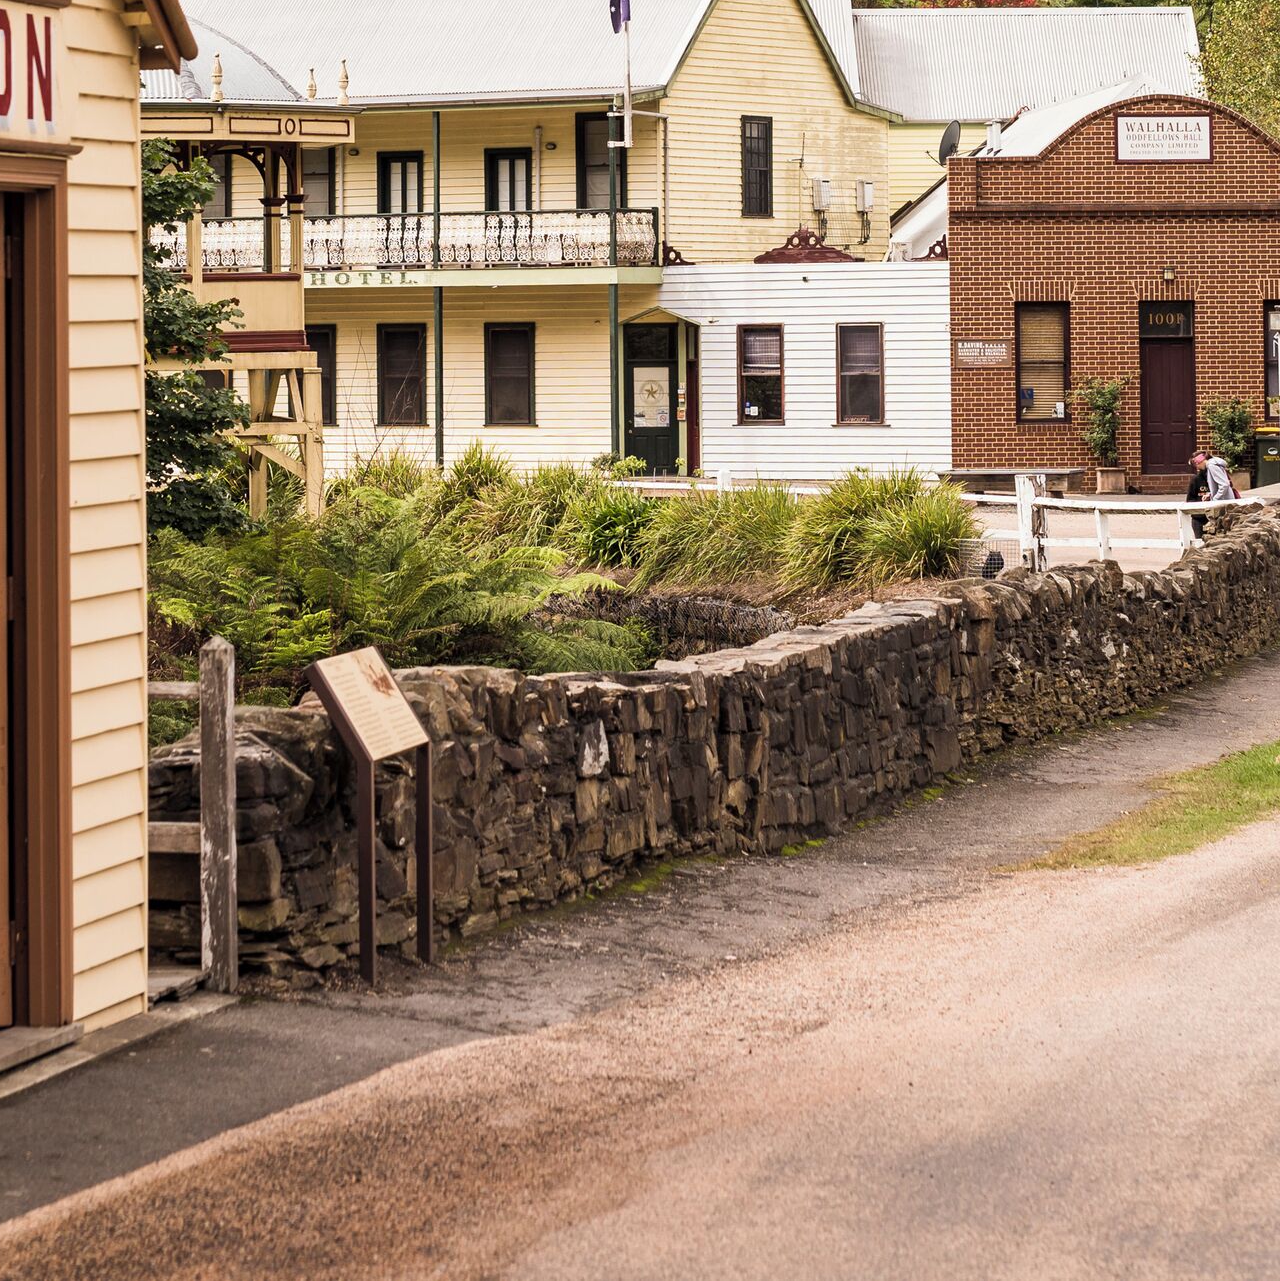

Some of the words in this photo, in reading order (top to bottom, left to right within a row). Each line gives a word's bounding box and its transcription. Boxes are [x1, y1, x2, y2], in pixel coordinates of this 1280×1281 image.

[1125, 122, 1202, 132] WALHALLA
[1126, 133, 1180, 141] ODDFELLOWS
[1183, 133, 1203, 141] HALL
